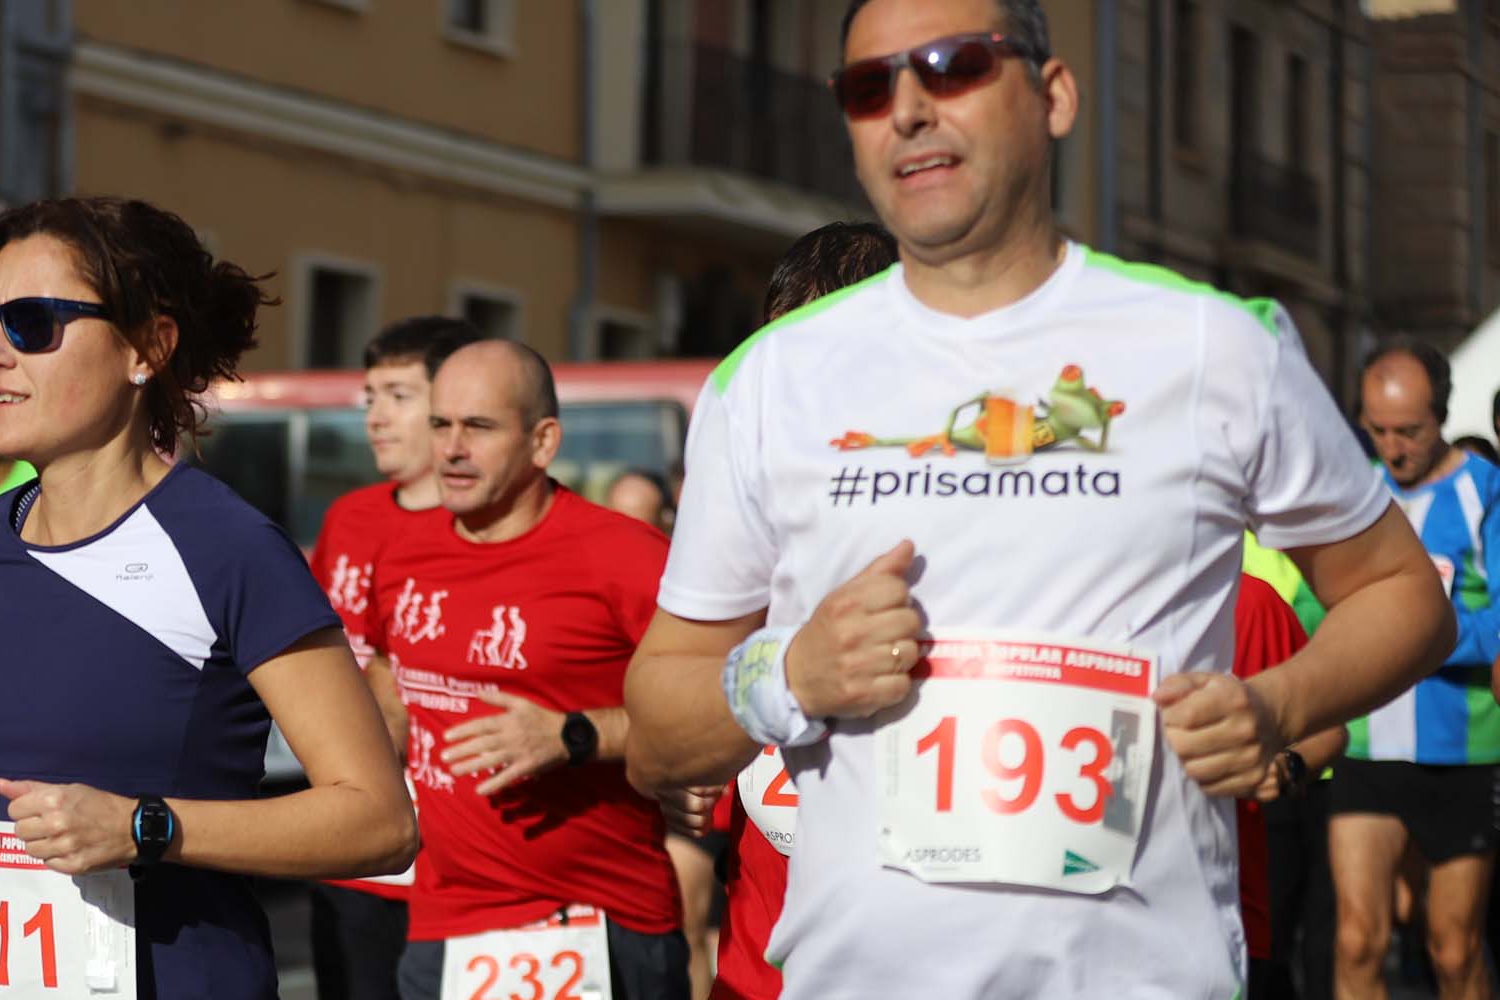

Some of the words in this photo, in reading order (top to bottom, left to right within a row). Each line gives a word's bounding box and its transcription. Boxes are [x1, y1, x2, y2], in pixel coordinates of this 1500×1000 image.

[829, 463, 1121, 506] #prisamata
[1065, 650, 1142, 677] ASPRODES
[916, 716, 1114, 825] 193
